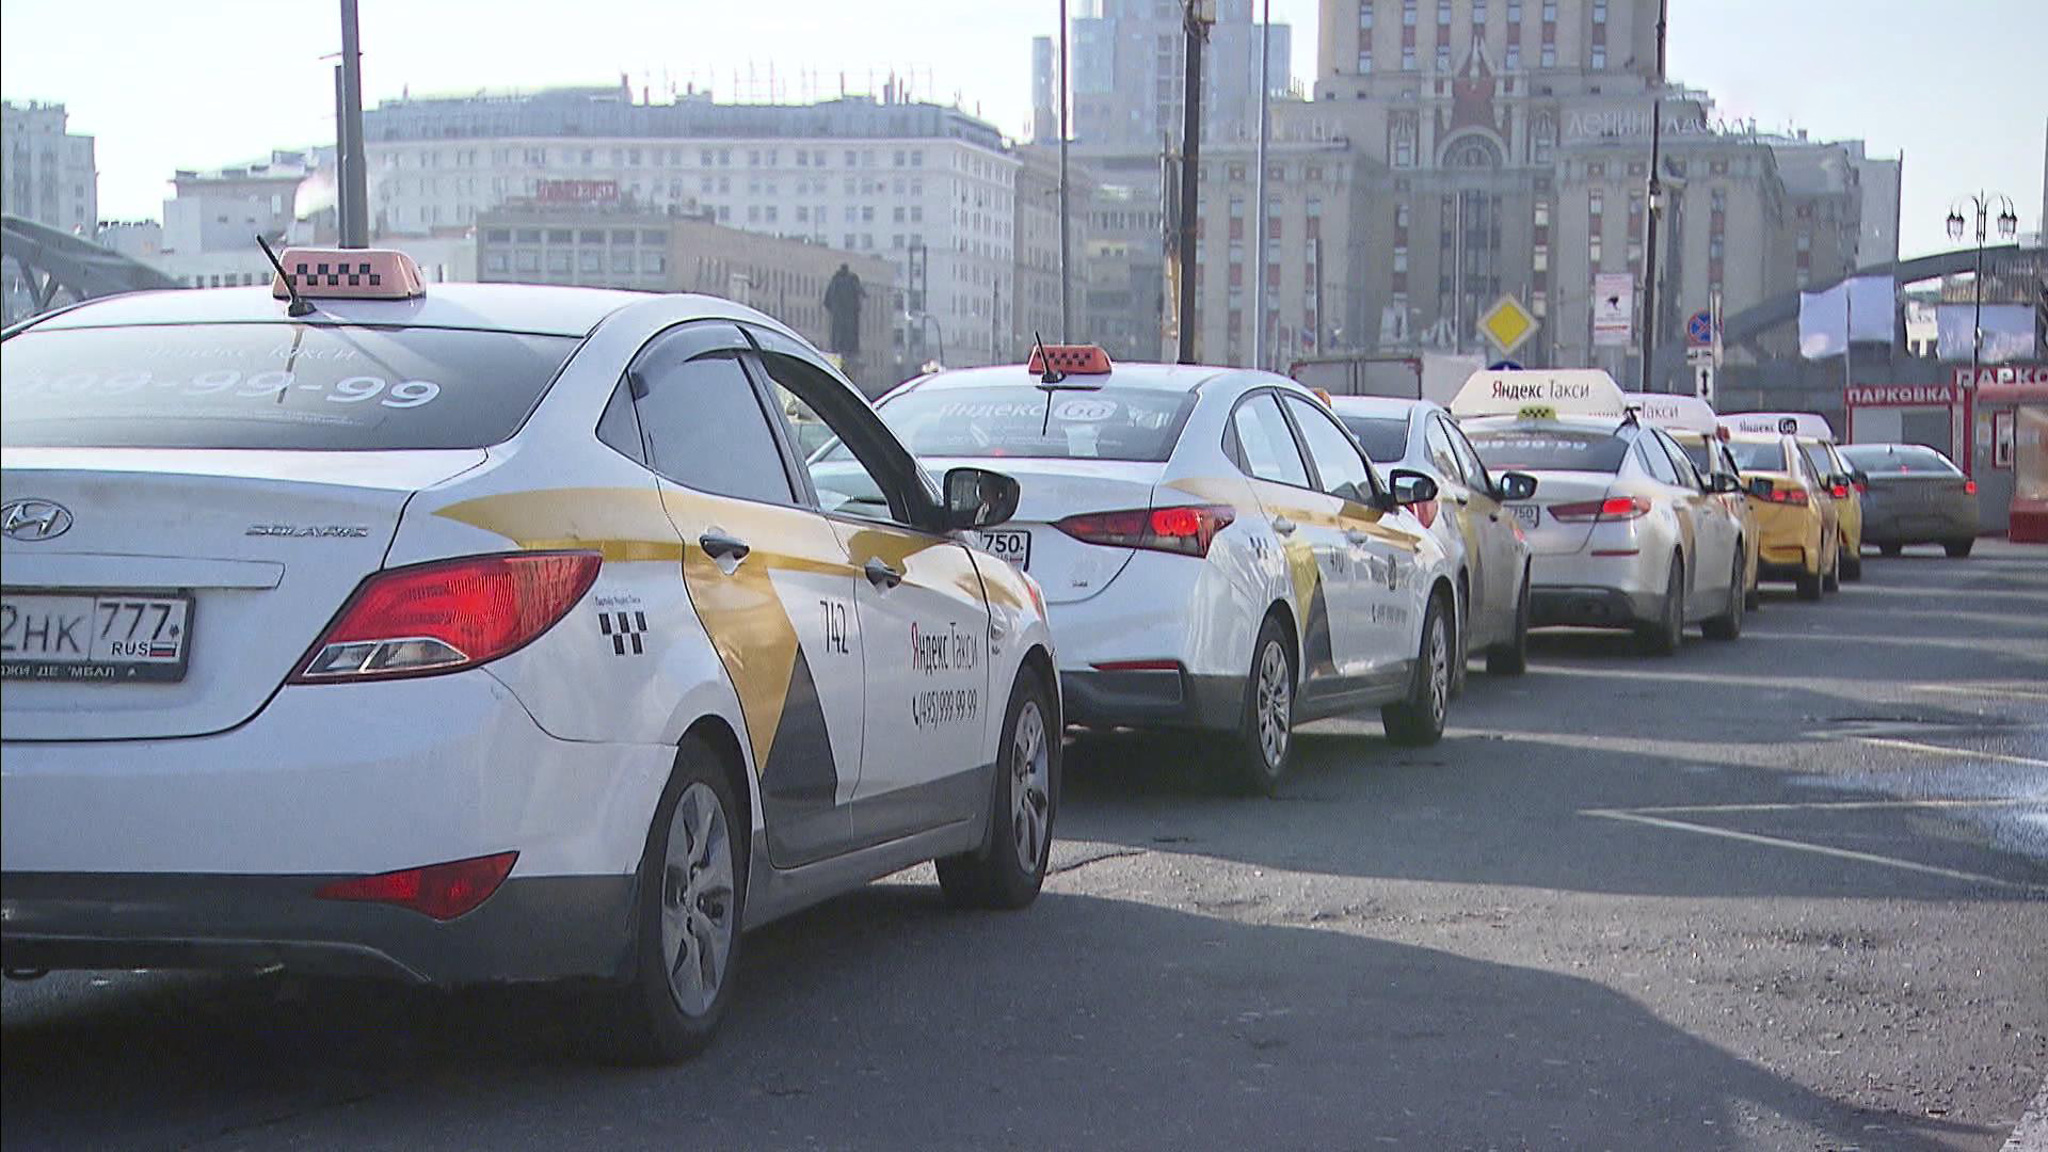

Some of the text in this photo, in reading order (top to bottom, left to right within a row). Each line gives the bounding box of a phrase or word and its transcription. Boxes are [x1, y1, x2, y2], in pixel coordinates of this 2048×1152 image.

[1491, 378, 1590, 401] Яндекс Такси
[1847, 388, 1951, 404] ПАРКОВКА
[983, 534, 1021, 553] 750
[98, 602, 171, 641] 777
[819, 600, 849, 654] 742
[110, 641, 149, 656] RUS
[911, 621, 978, 675] Яндекс Такси
